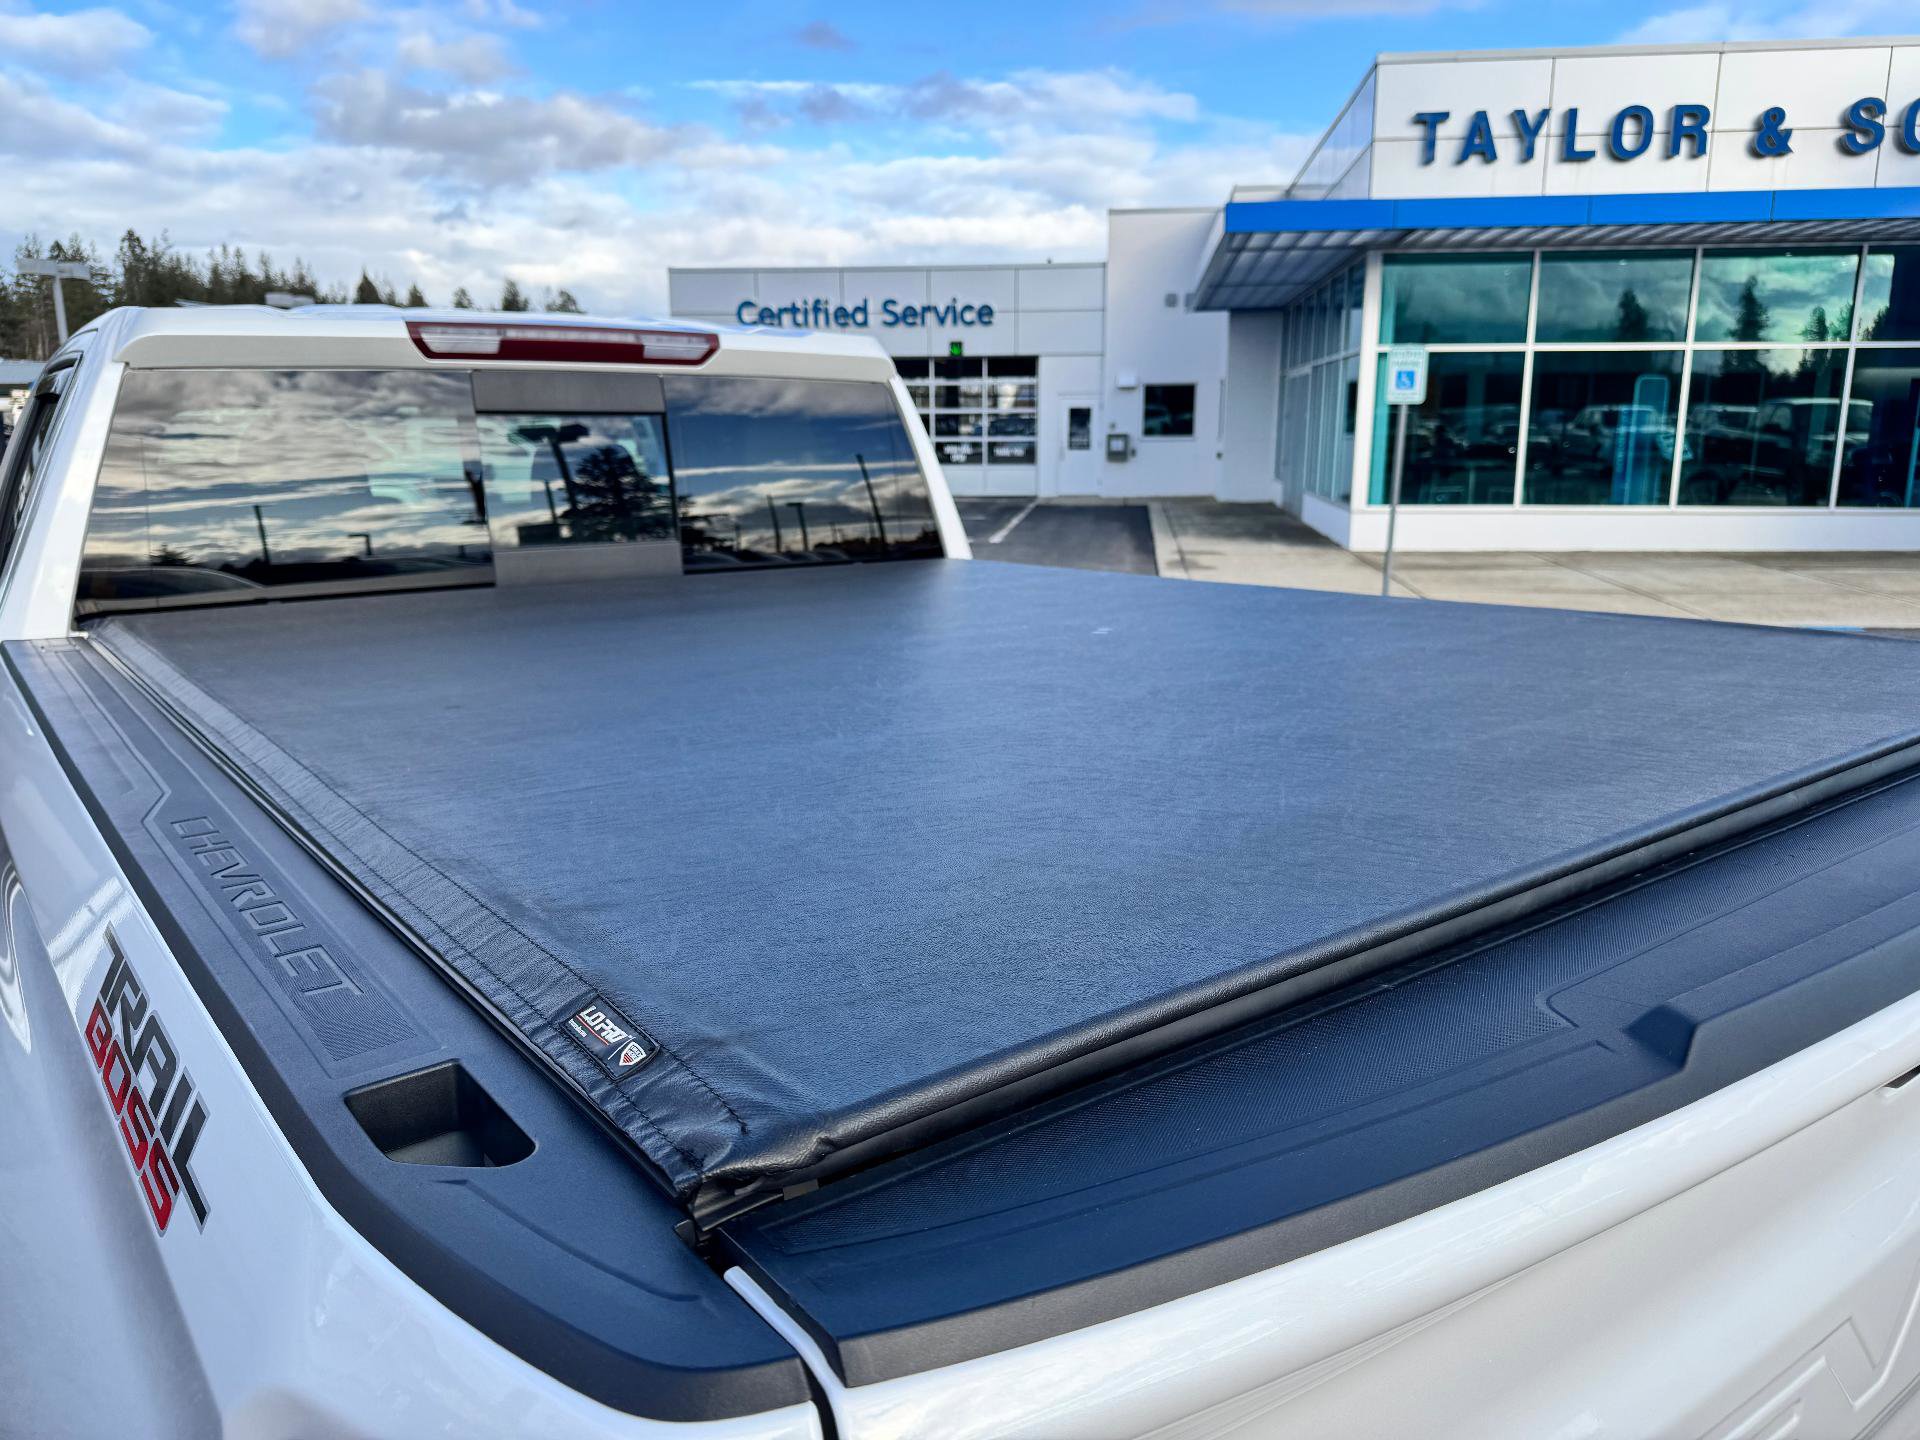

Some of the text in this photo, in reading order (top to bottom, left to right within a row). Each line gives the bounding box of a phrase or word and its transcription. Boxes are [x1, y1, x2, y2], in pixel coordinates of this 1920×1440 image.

[1413, 104, 1711, 165] TAYLOR
[1753, 106, 1793, 158] &
[737, 297, 994, 328] Certified Service
[170, 816, 365, 1000] CHEVROLET
[84, 997, 181, 1234] BOSS
[99, 921, 211, 1231] TRAIL
